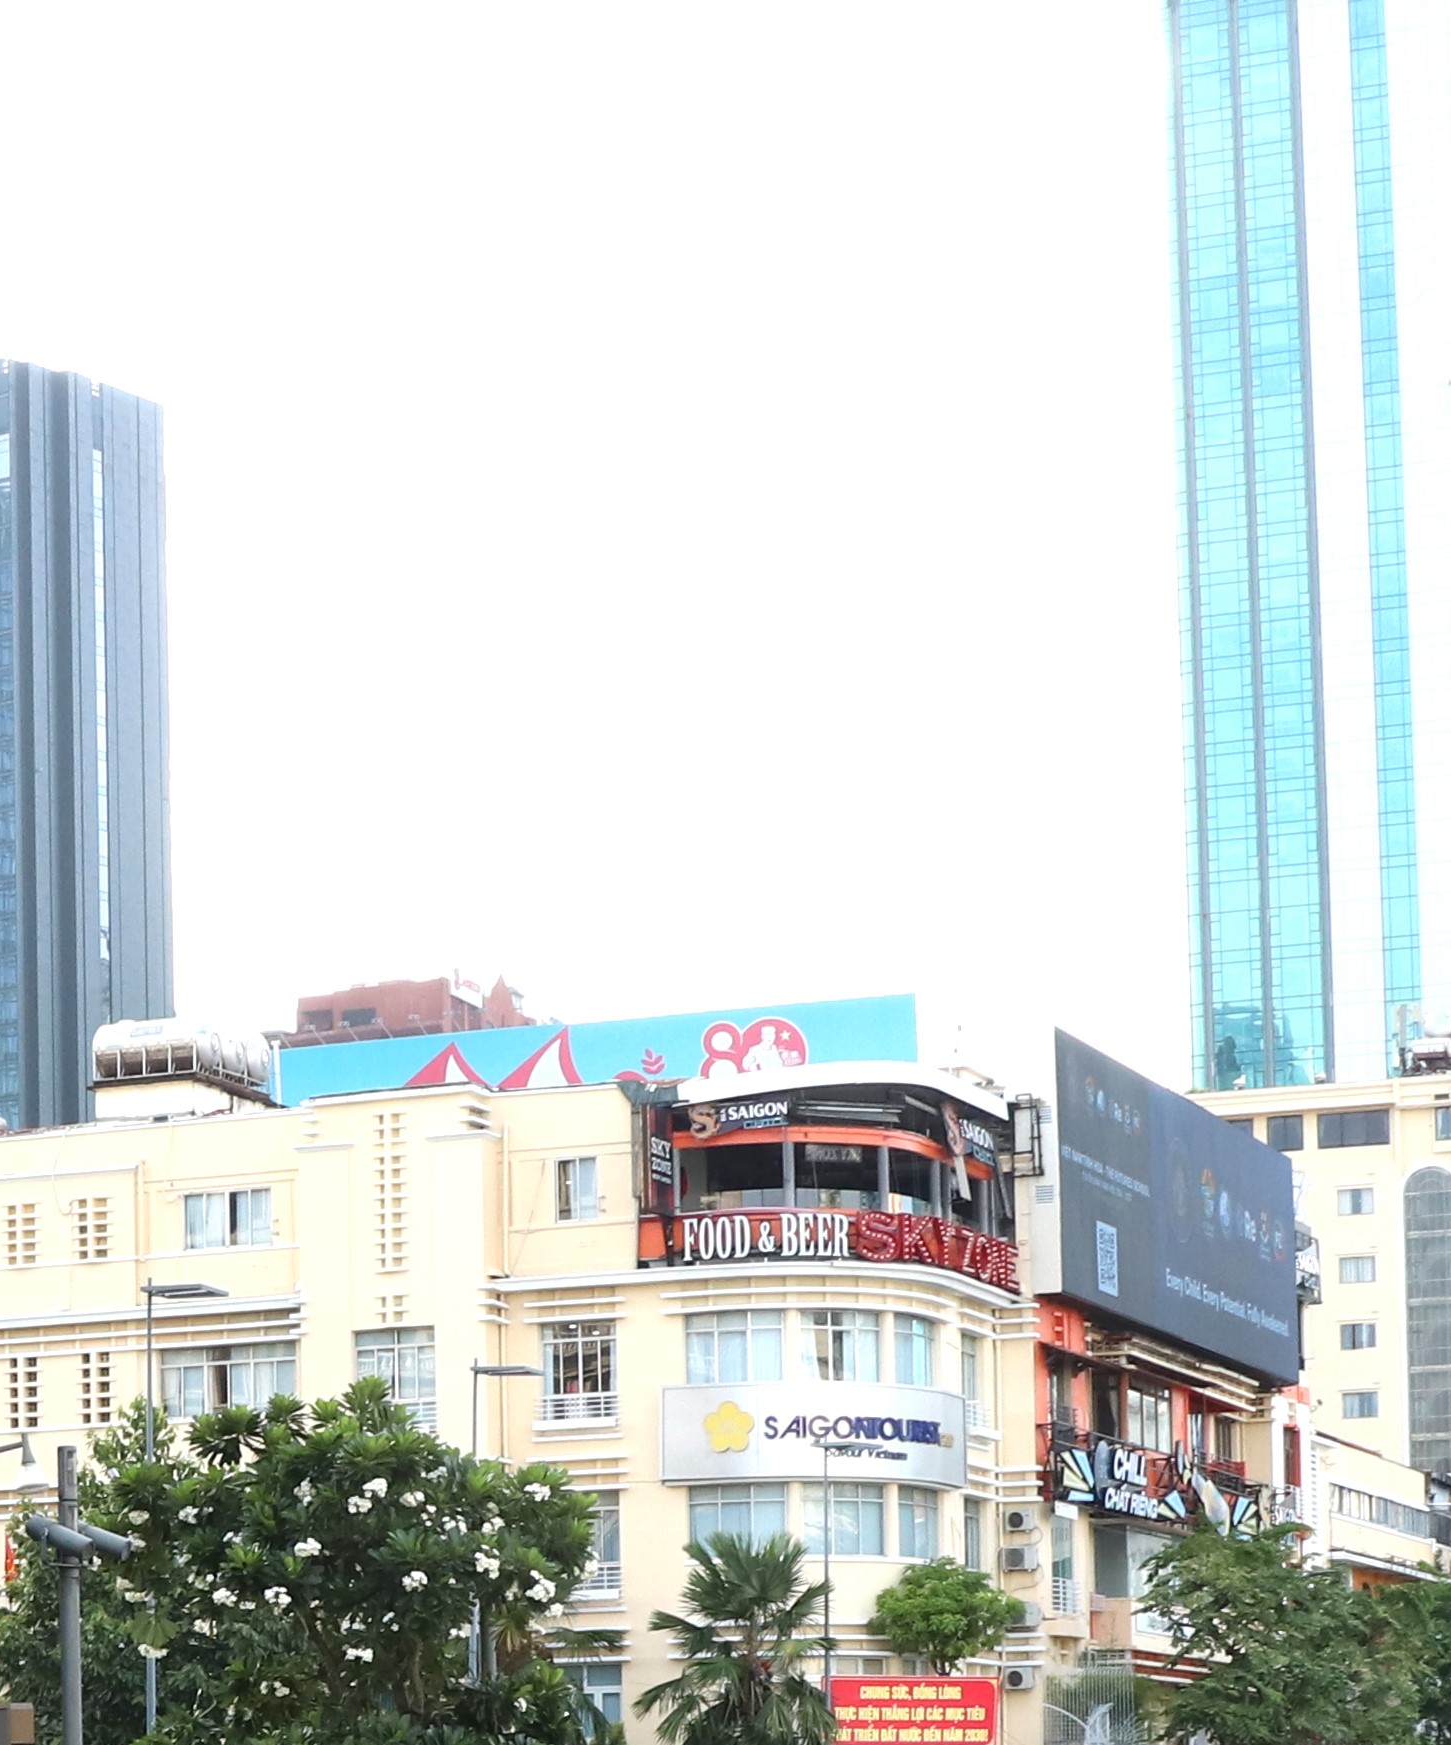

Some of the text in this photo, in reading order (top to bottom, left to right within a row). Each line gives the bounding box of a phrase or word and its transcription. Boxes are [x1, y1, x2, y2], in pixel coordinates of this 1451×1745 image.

[728, 1101, 788, 1120] SAIGON
[651, 1136, 671, 1159] SKY
[682, 1215, 750, 1262] FOOD
[758, 1221, 776, 1253] &
[780, 1213, 851, 1257] BEER
[856, 1209, 957, 1265] SKY
[764, 1415, 940, 1444] SAIGONTOURIST
[1114, 1449, 1147, 1486] CHILL
[860, 1686, 890, 1699] CHUNG
[938, 1684, 961, 1699] LÒNG
[858, 1705, 880, 1723] HIỆN
[881, 1703, 910, 1720] THẮNG
[926, 1705, 943, 1721] CÁC
[945, 1707, 965, 1723] MỤC
[967, 1705, 986, 1720] TIÊU
[835, 1725, 852, 1742] HÁT
[881, 1725, 898, 1742] ĐẤT
[923, 1725, 941, 1742] ĐẾN
[943, 1726, 963, 1742] NĂM
